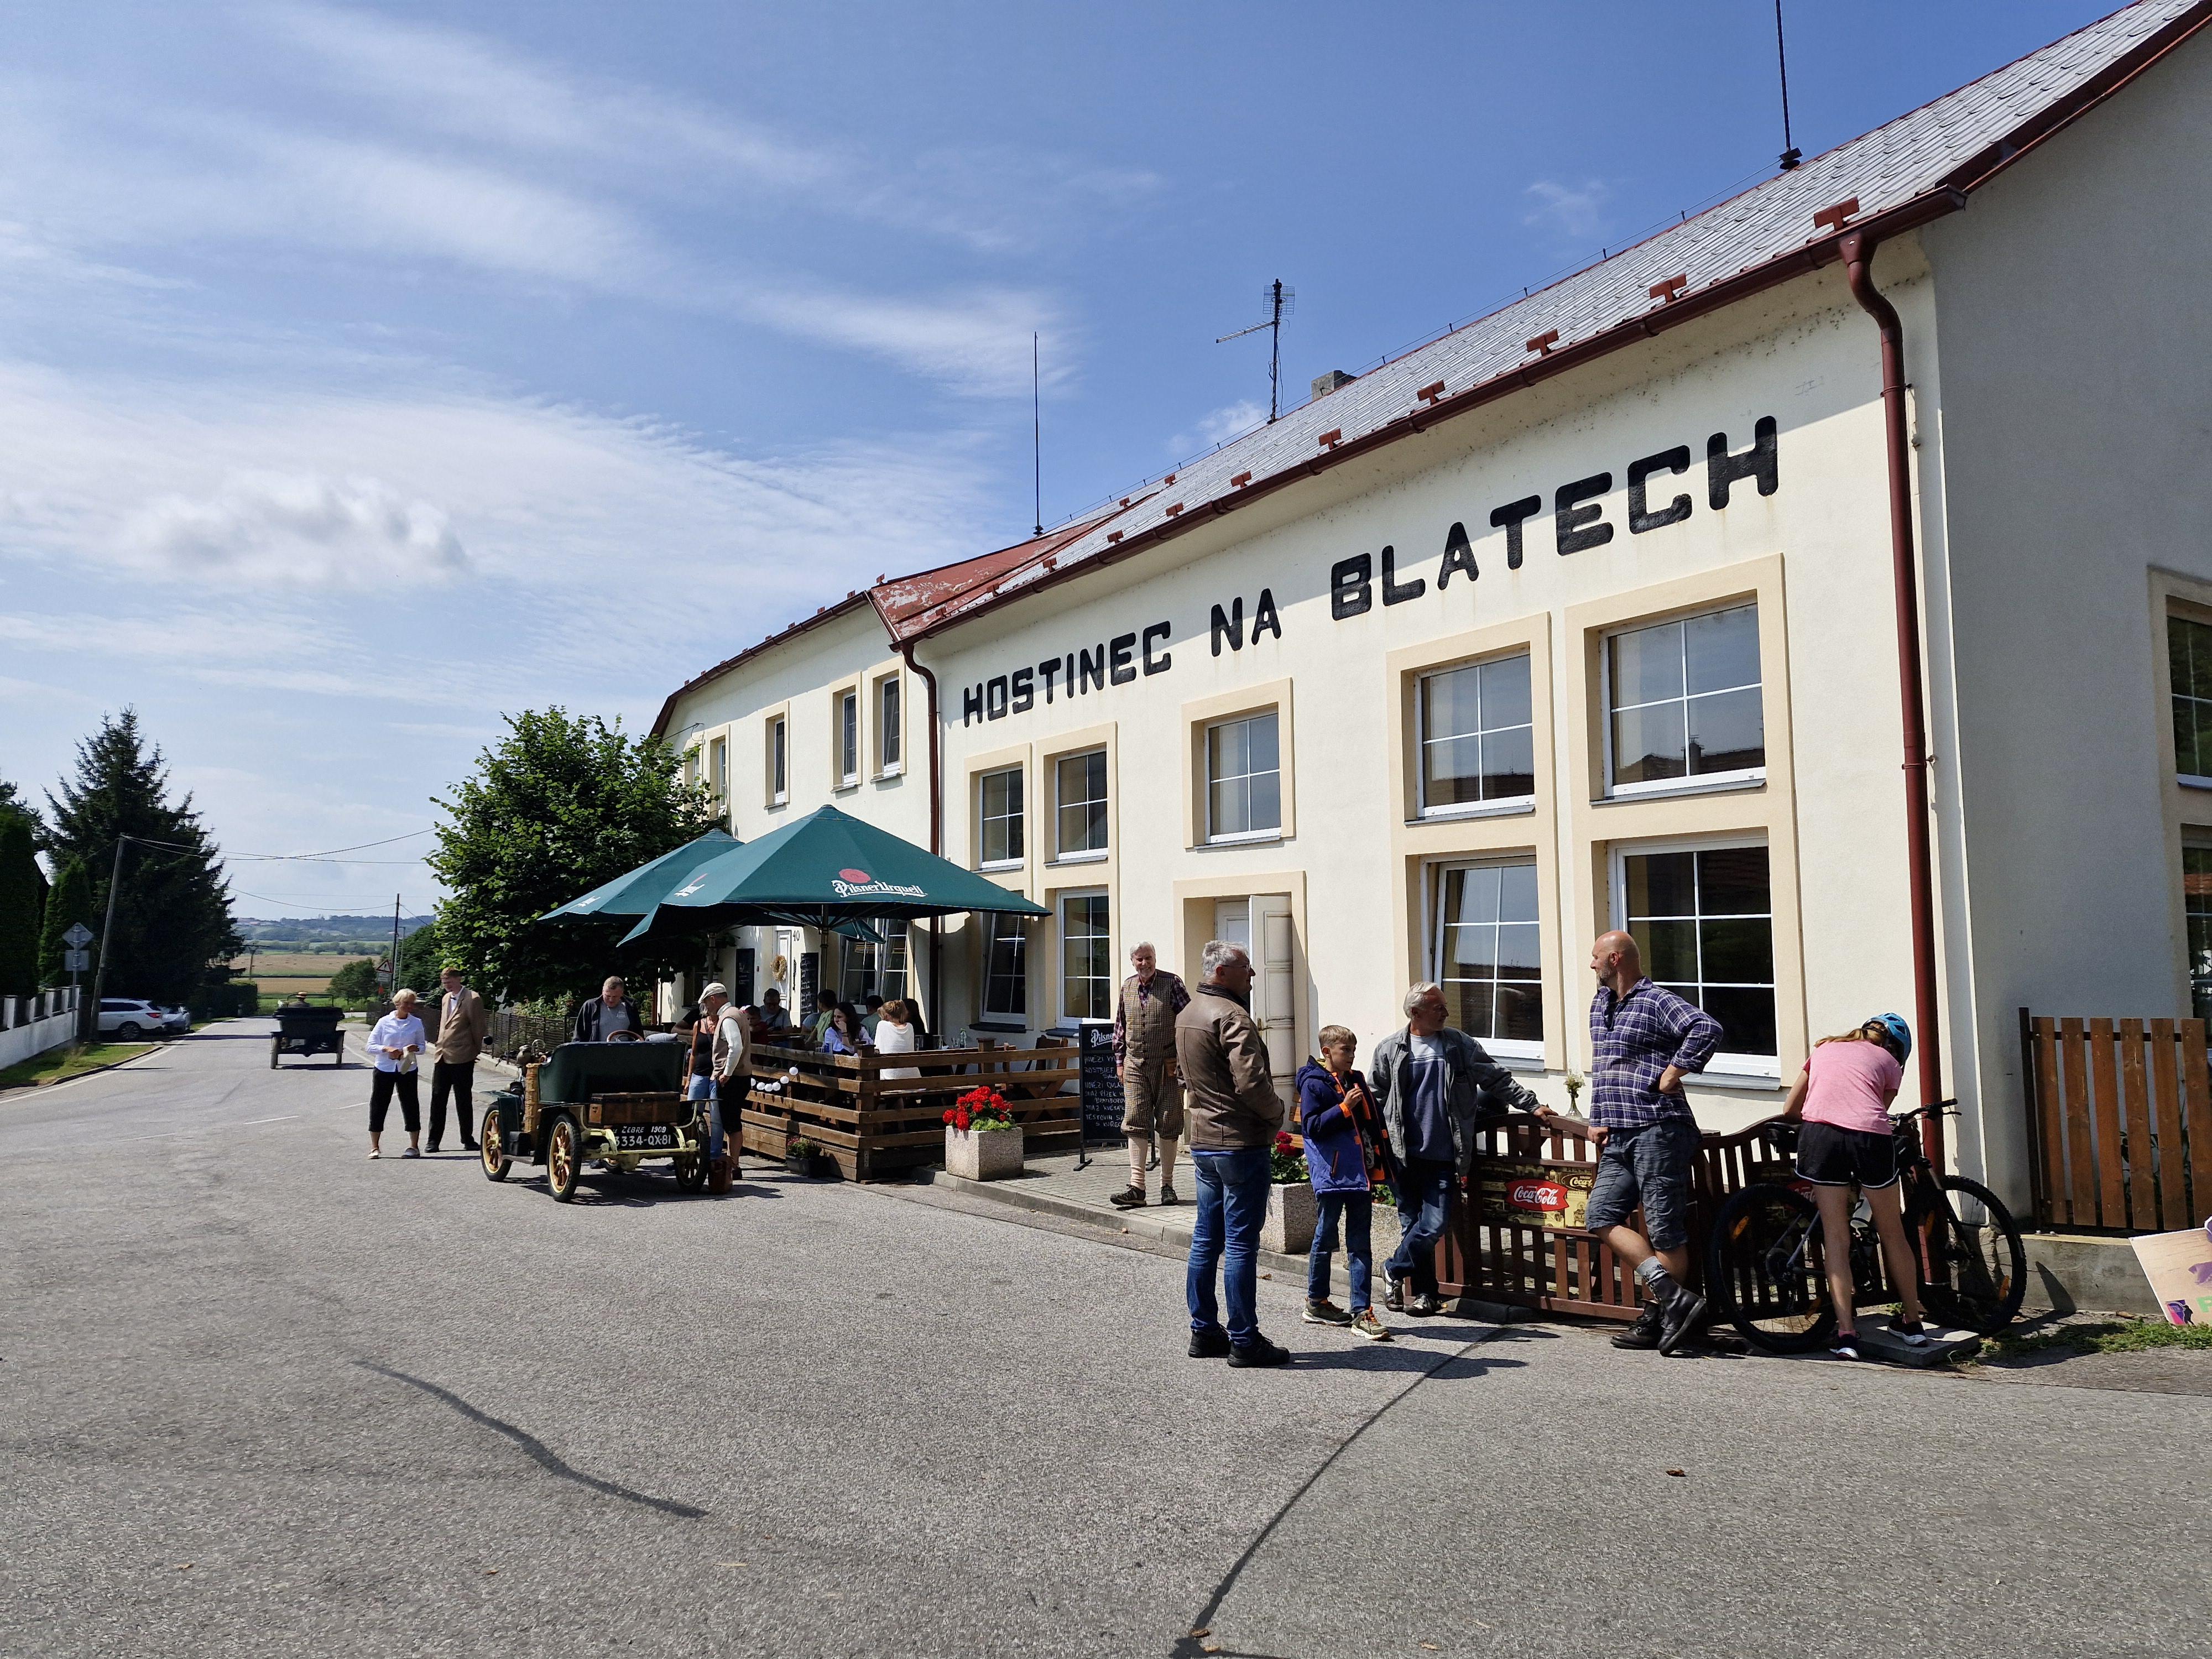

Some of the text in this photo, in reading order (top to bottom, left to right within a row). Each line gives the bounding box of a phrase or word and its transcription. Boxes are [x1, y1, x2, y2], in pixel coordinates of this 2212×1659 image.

[963, 415, 1778, 728] HOSTINEC NA BLATECH
[831, 880, 926, 898] Pilsner Urquell
[792, 930, 800, 942] 40
[1091, 1029, 1113, 1048] Pilsne
[1514, 1185, 1558, 1206] Coca-Cola
